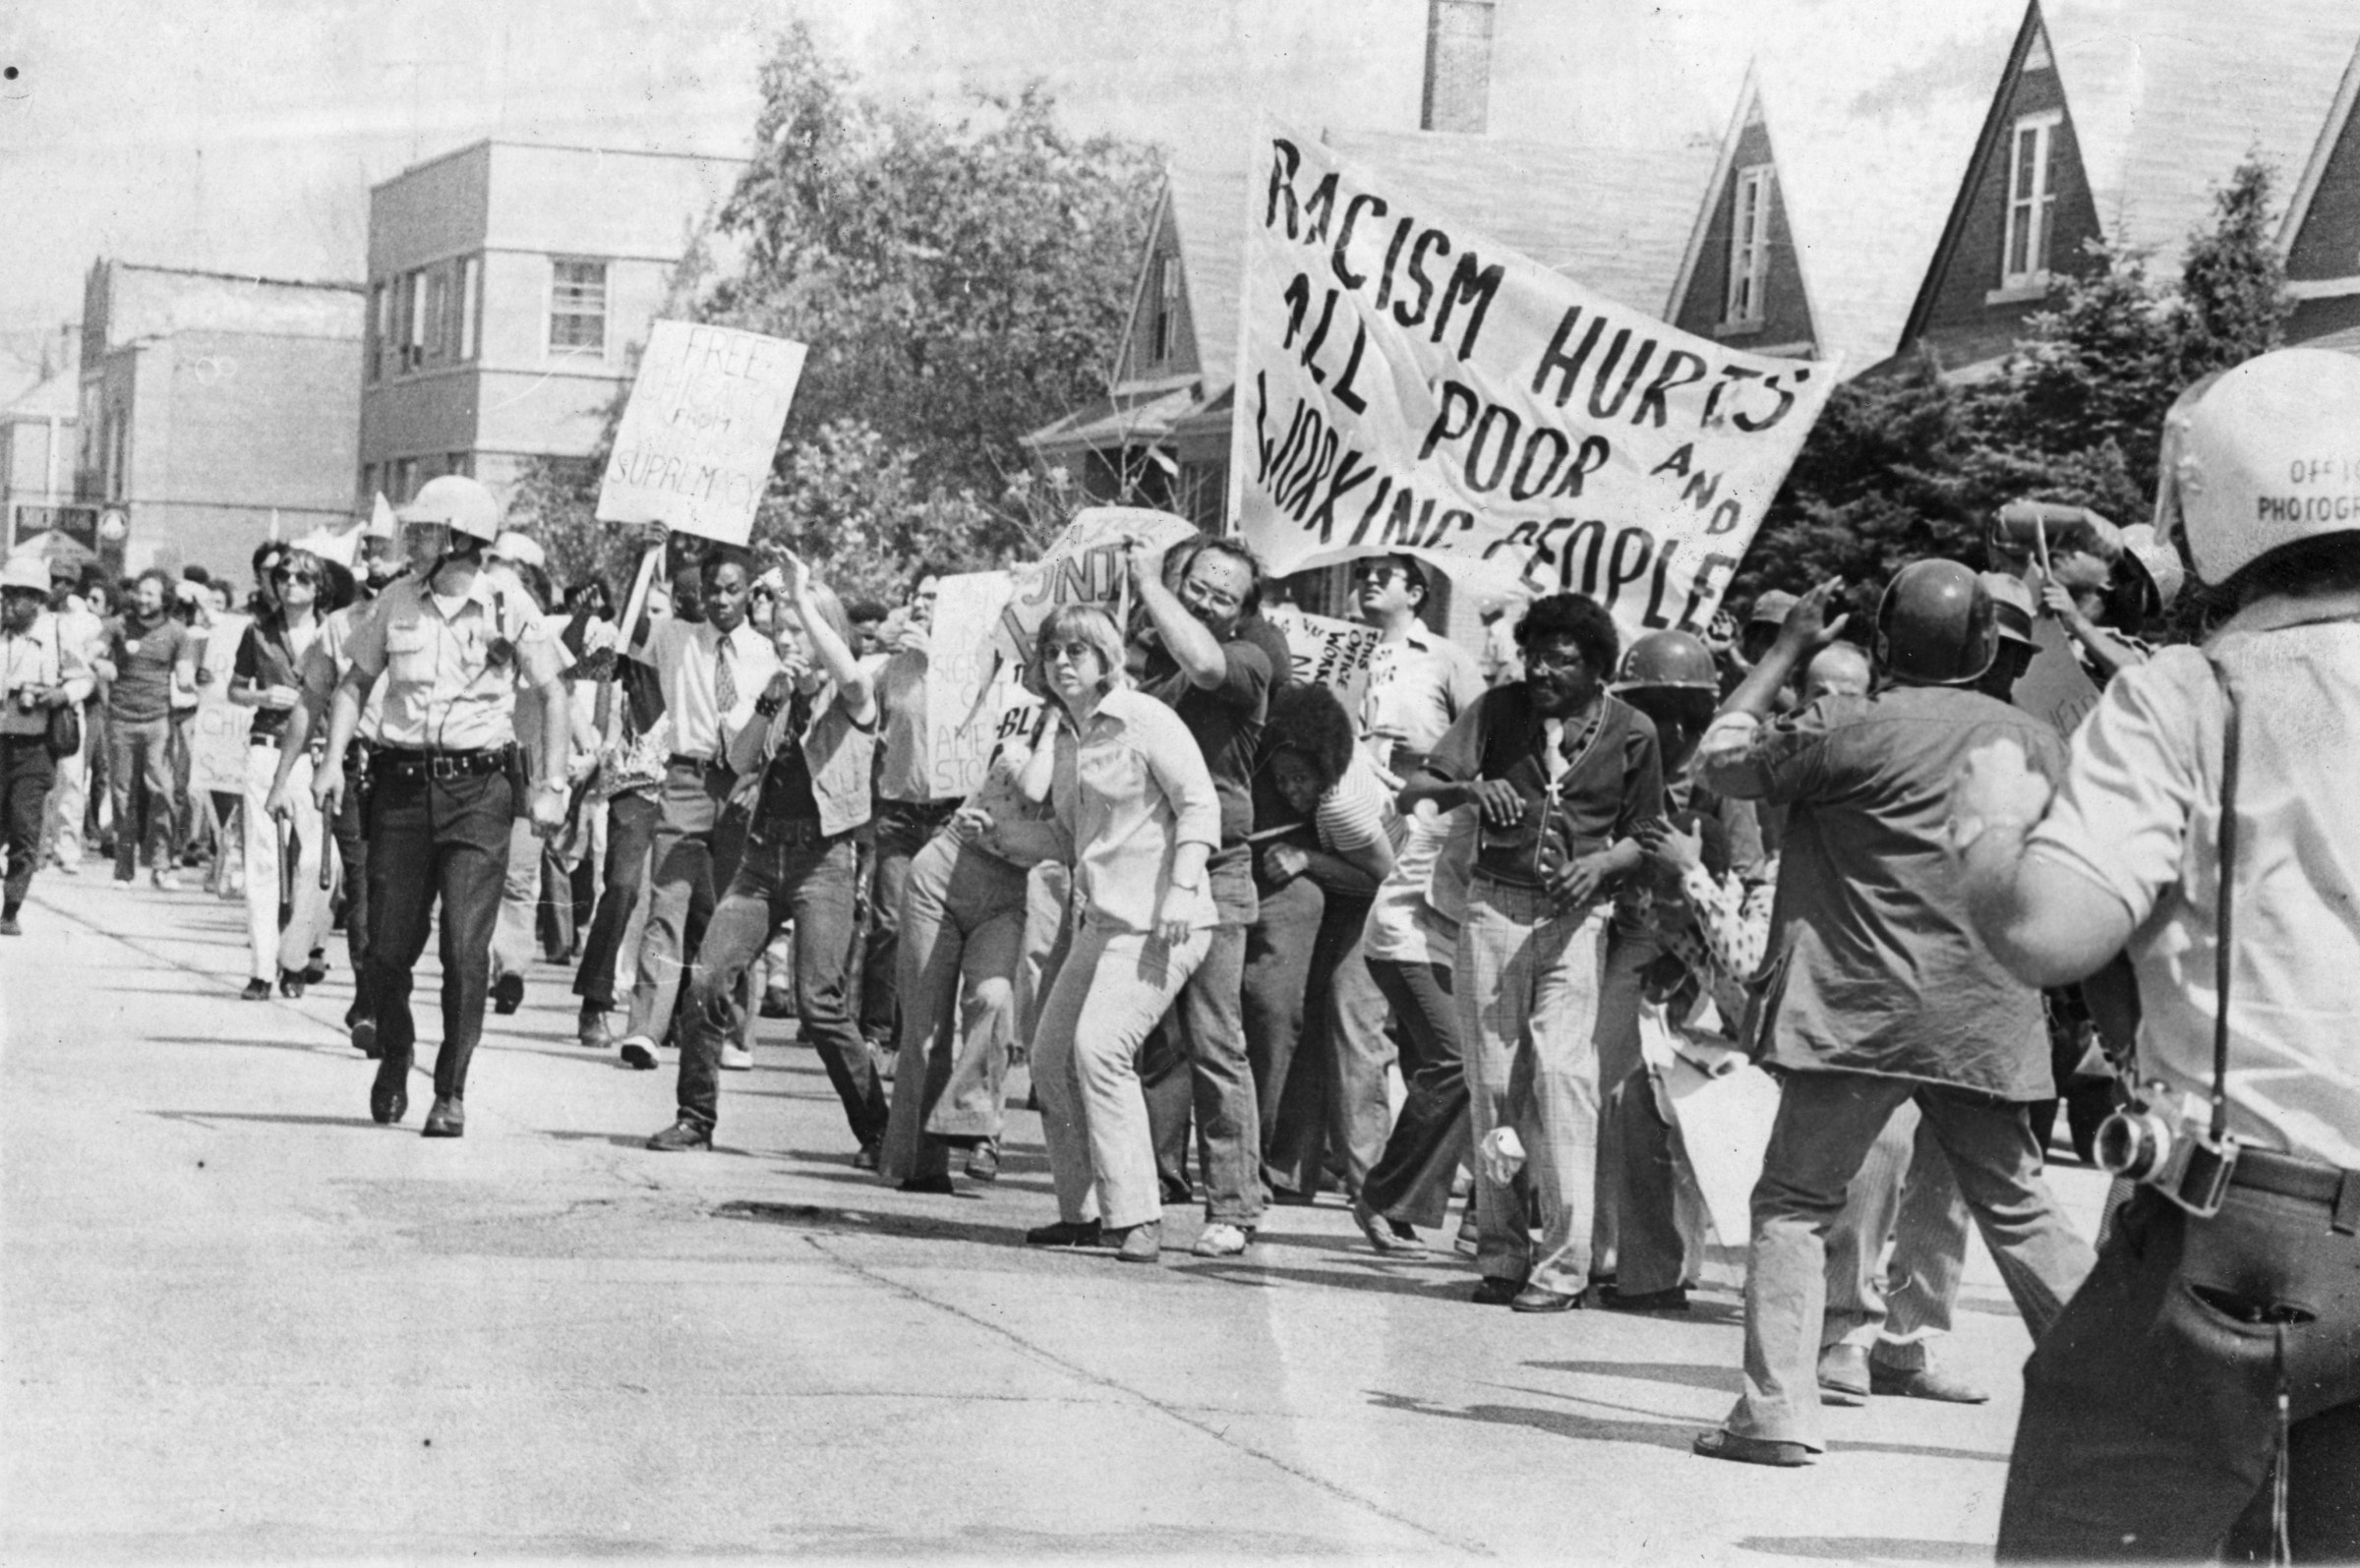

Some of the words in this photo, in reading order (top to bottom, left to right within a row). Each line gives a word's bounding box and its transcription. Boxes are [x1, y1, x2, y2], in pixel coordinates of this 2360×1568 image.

[1266, 138, 1505, 362] RACISM
[1531, 305, 1810, 433] HURTS
[683, 327, 775, 383] FREE
[1282, 272, 1368, 415] ALL
[1417, 380, 1611, 502] POOR
[1649, 441, 1741, 535] AND
[1335, 628, 1363, 691] OFFICE
[935, 724, 986, 758] AME
